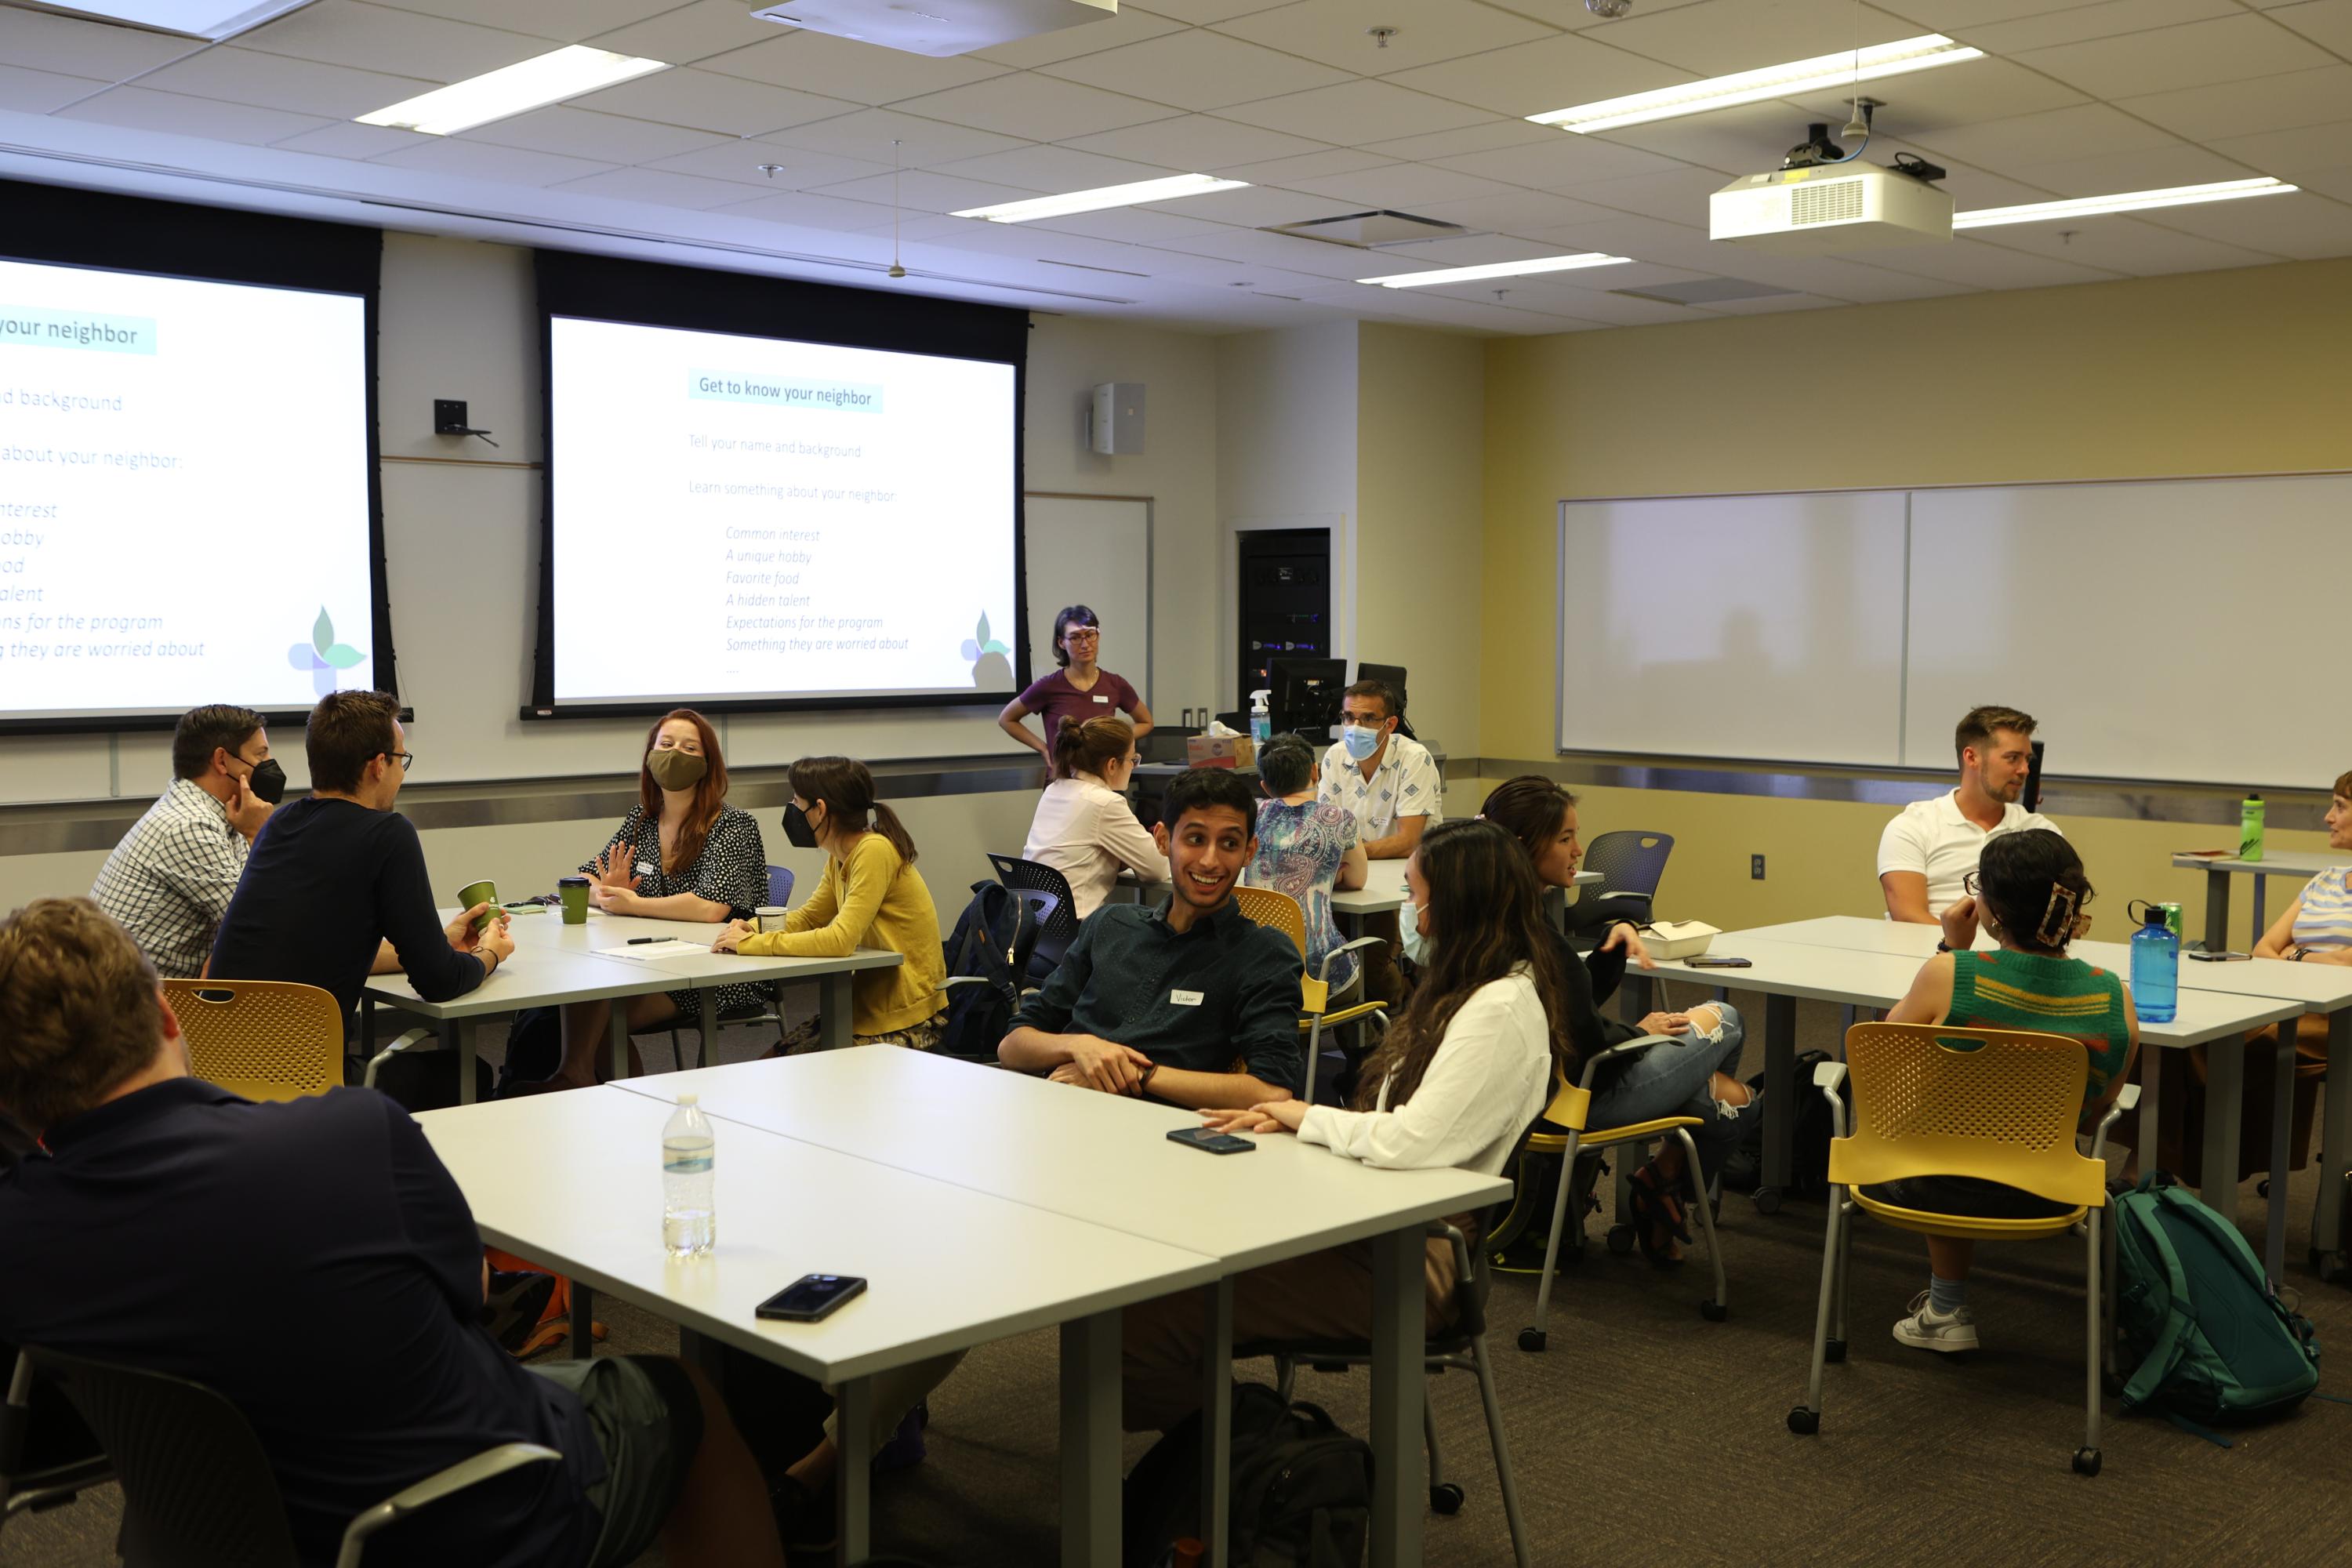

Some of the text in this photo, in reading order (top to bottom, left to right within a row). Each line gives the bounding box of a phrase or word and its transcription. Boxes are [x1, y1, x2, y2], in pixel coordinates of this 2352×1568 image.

[48, 321, 138, 345] neighbor
[20, 388, 122, 412] background
[699, 376, 872, 407] Get to know your neighbor
[688, 434, 862, 459] Tell your name and background
[2, 444, 183, 471] about your neighbor:
[688, 480, 720, 494] Learn
[724, 481, 784, 499] something
[786, 485, 818, 499] about
[821, 488, 845, 502] your
[1, 529, 45, 550] obby
[725, 525, 821, 543] Common interest
[0, 557, 25, 574] od
[725, 548, 812, 566] A unique hobby
[725, 571, 800, 588] Favorite food
[725, 593, 811, 607] A hidden talent
[26, 612, 53, 634] for
[58, 613, 85, 630] the
[90, 615, 163, 633] program
[725, 615, 884, 633] Expectations for the program
[11, 641, 49, 660] they
[54, 643, 82, 657] are
[89, 640, 153, 657] worried
[158, 640, 205, 657] about
[725, 636, 909, 654] Something they are worried about
